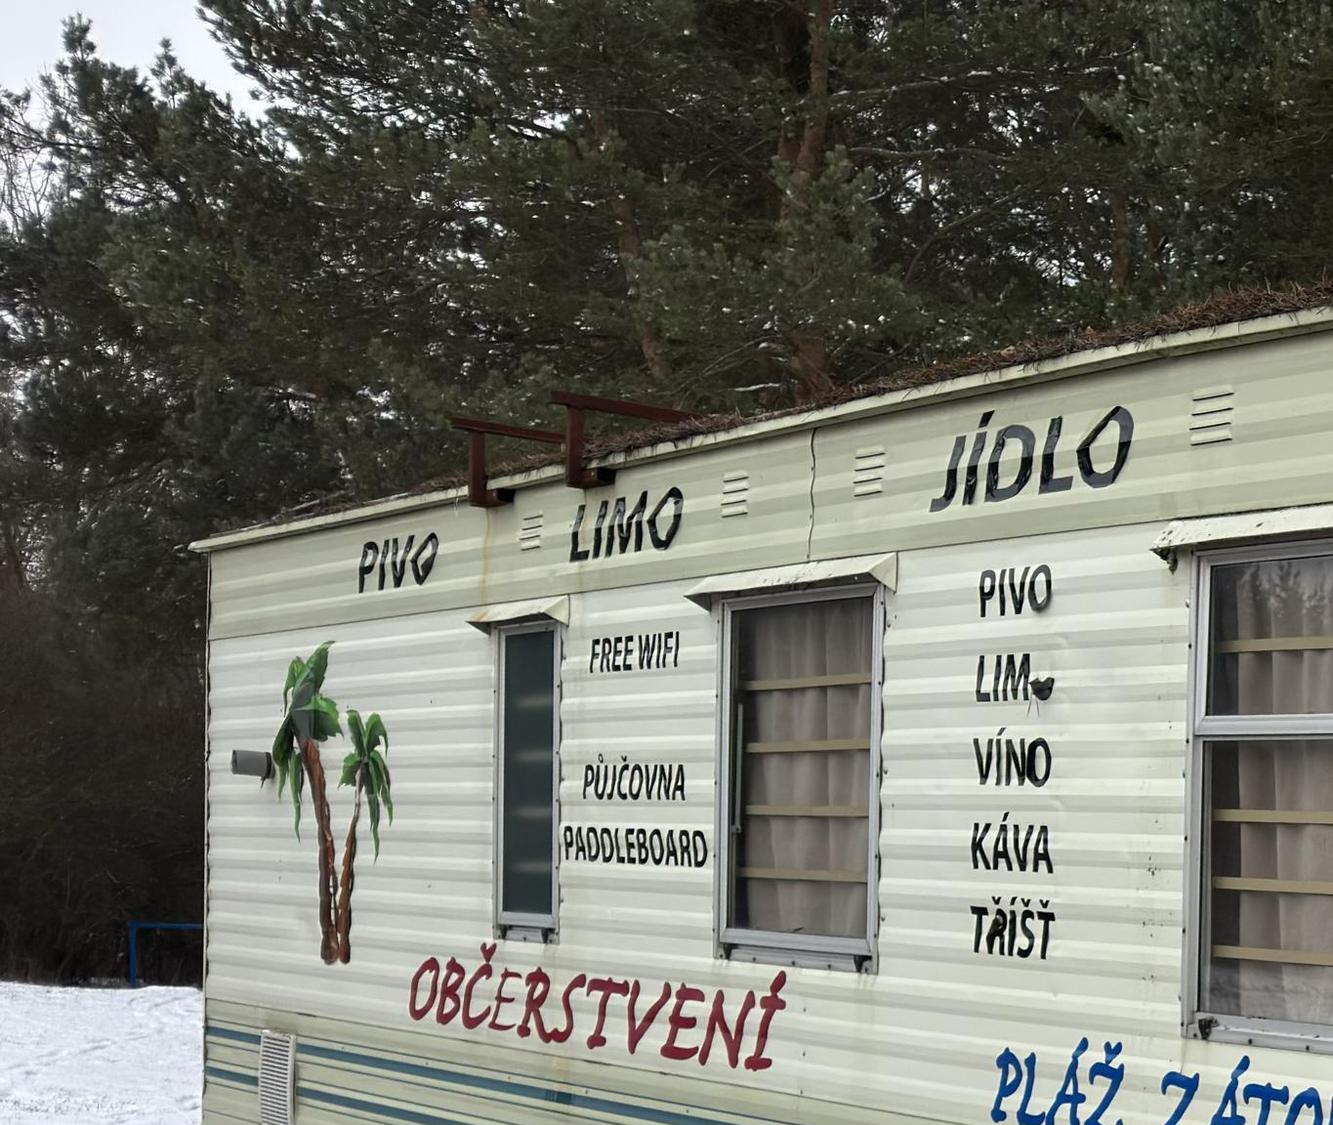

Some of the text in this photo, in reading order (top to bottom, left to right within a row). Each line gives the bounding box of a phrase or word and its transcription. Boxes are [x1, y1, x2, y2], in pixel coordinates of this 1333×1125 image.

[929, 405, 1134, 512] JÍDLO
[570, 486, 684, 563] LIMO
[358, 531, 438, 593] PIVO
[978, 564, 1053, 618] PIVO
[589, 631, 680, 674] FREE WIFI
[582, 753, 686, 802] PŮJČOVNA
[972, 727, 1052, 788] VÍNO
[563, 825, 708, 868] PADDLEBOARD
[971, 812, 1055, 875] KÁVA
[970, 896, 1056, 961] TŘÍŠŤ
[408, 942, 786, 1071] OBČERSTVENÍ
